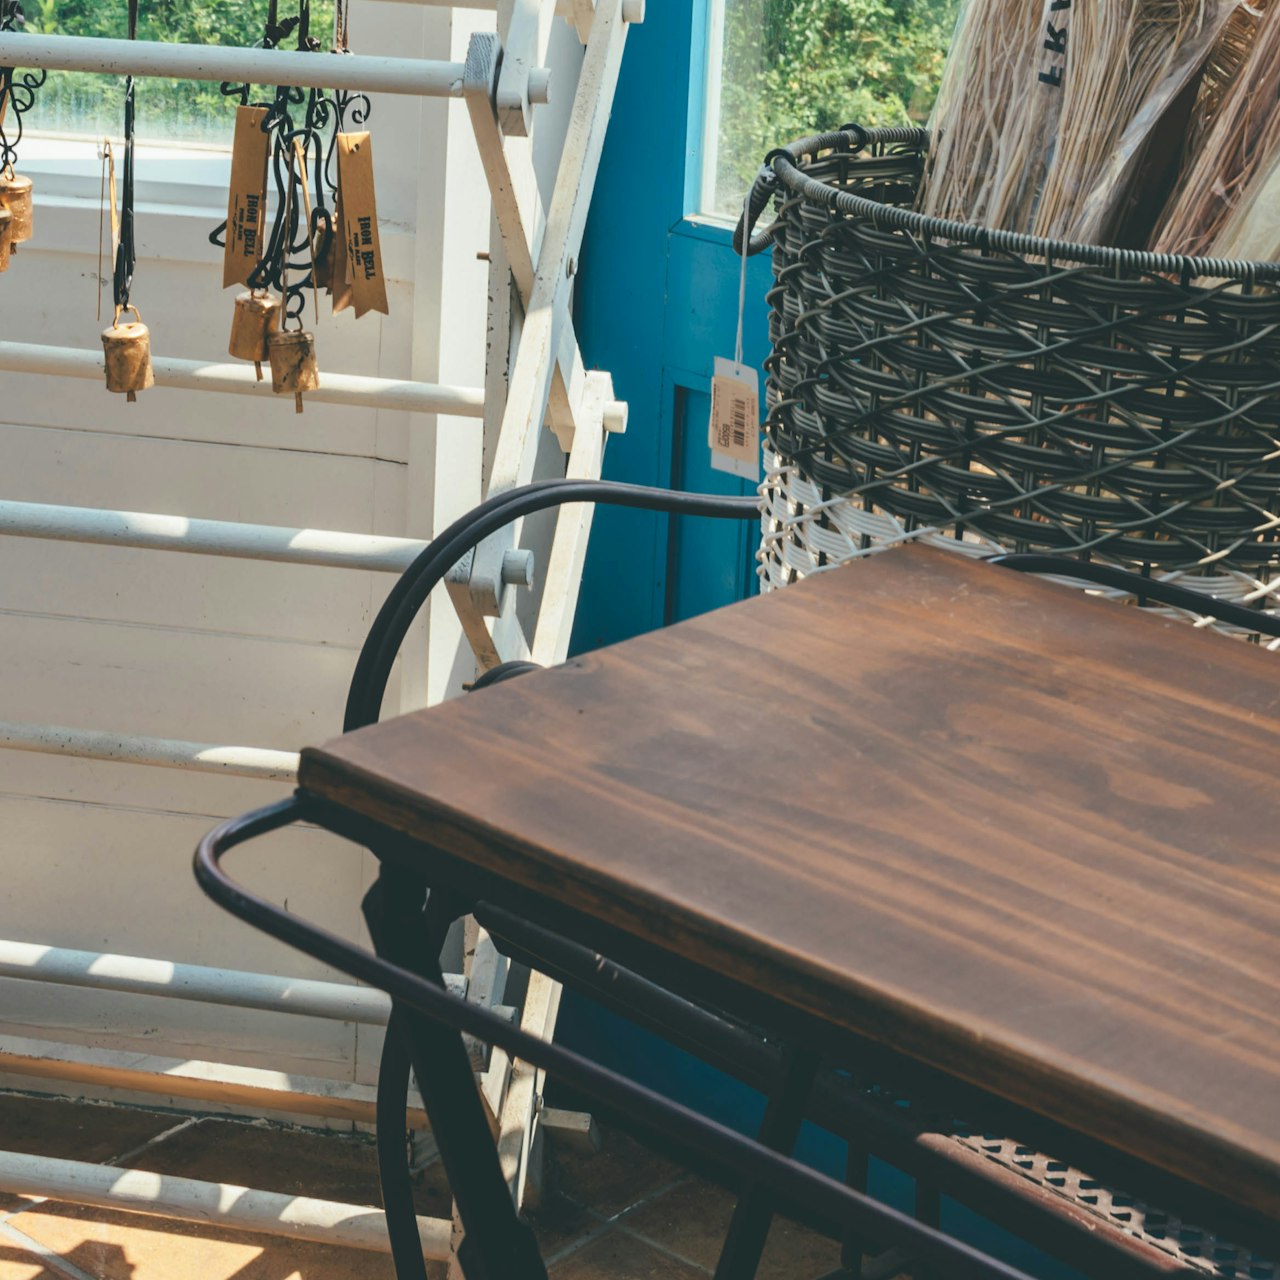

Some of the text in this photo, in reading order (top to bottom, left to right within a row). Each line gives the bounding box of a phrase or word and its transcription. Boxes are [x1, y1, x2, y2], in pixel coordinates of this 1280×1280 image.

[243, 194, 259, 257] IRON BELL
[357, 215, 376, 280] IRON BELL
